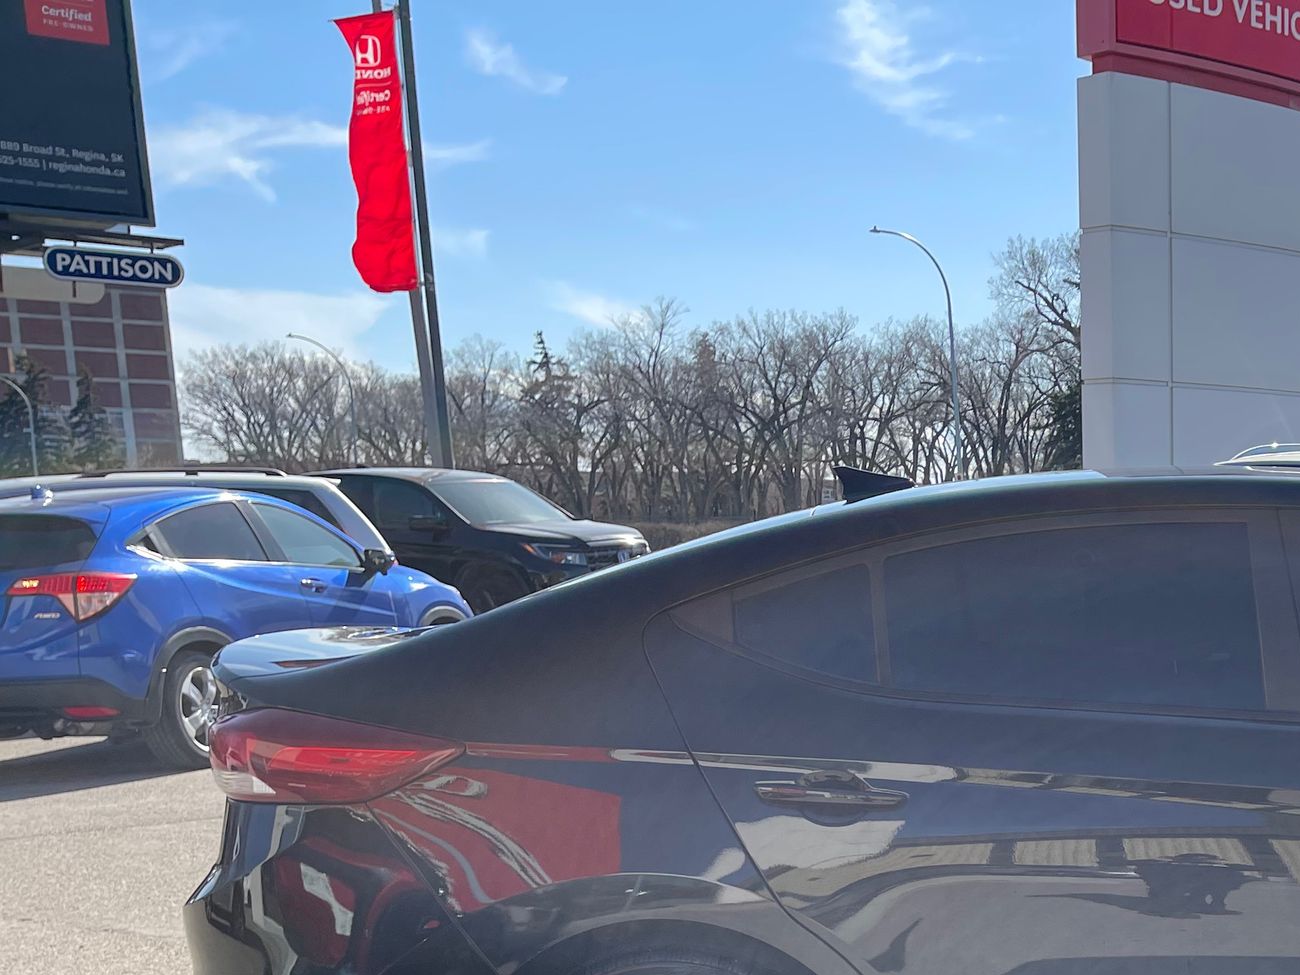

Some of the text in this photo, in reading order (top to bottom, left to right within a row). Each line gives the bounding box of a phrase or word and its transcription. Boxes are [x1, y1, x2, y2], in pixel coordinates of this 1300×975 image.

[41, 5, 92, 21] Certified
[1150, 0, 1223, 17] ED
[22, 143, 53, 156] Broad
[48, 162, 126, 178] reginahonda.ca
[55, 252, 173, 281] PATTISON
